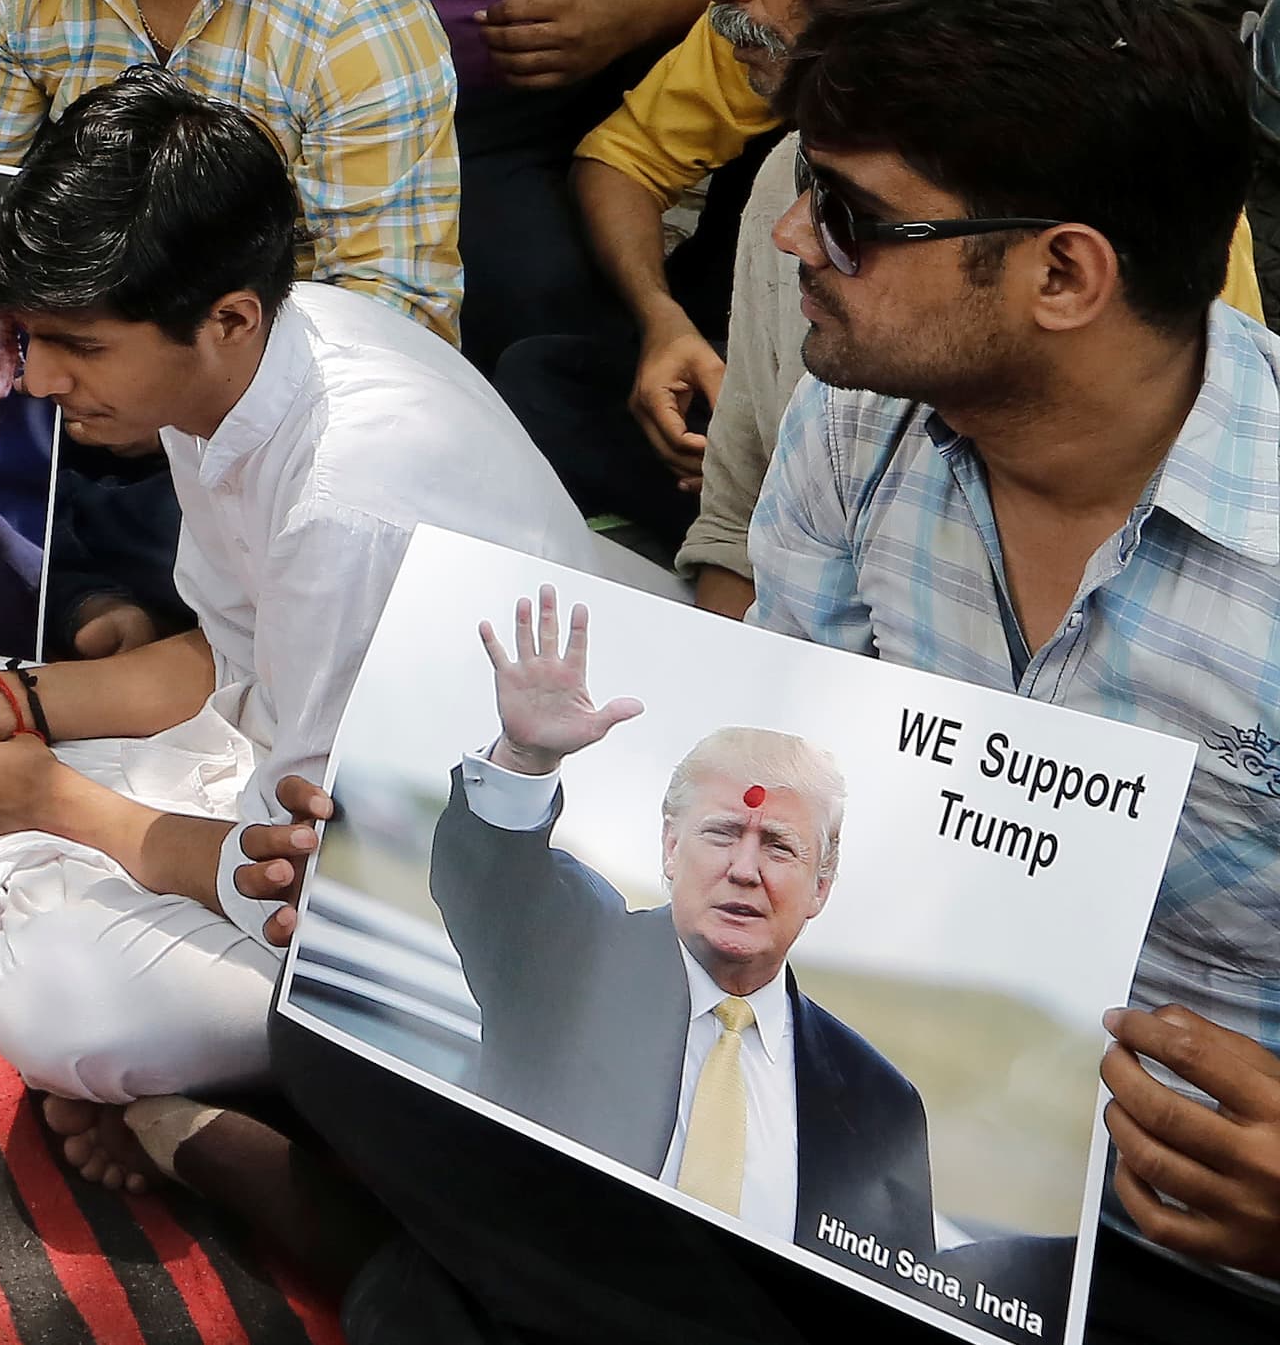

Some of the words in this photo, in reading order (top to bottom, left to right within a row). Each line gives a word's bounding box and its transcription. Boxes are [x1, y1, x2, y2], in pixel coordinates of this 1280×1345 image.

[898, 707, 963, 766] WE
[979, 731, 1147, 820] Support
[937, 789, 1060, 877] Trump
[816, 1212, 891, 1270] Hindu
[894, 1248, 969, 1308] Sena,
[973, 1282, 1044, 1338] India
